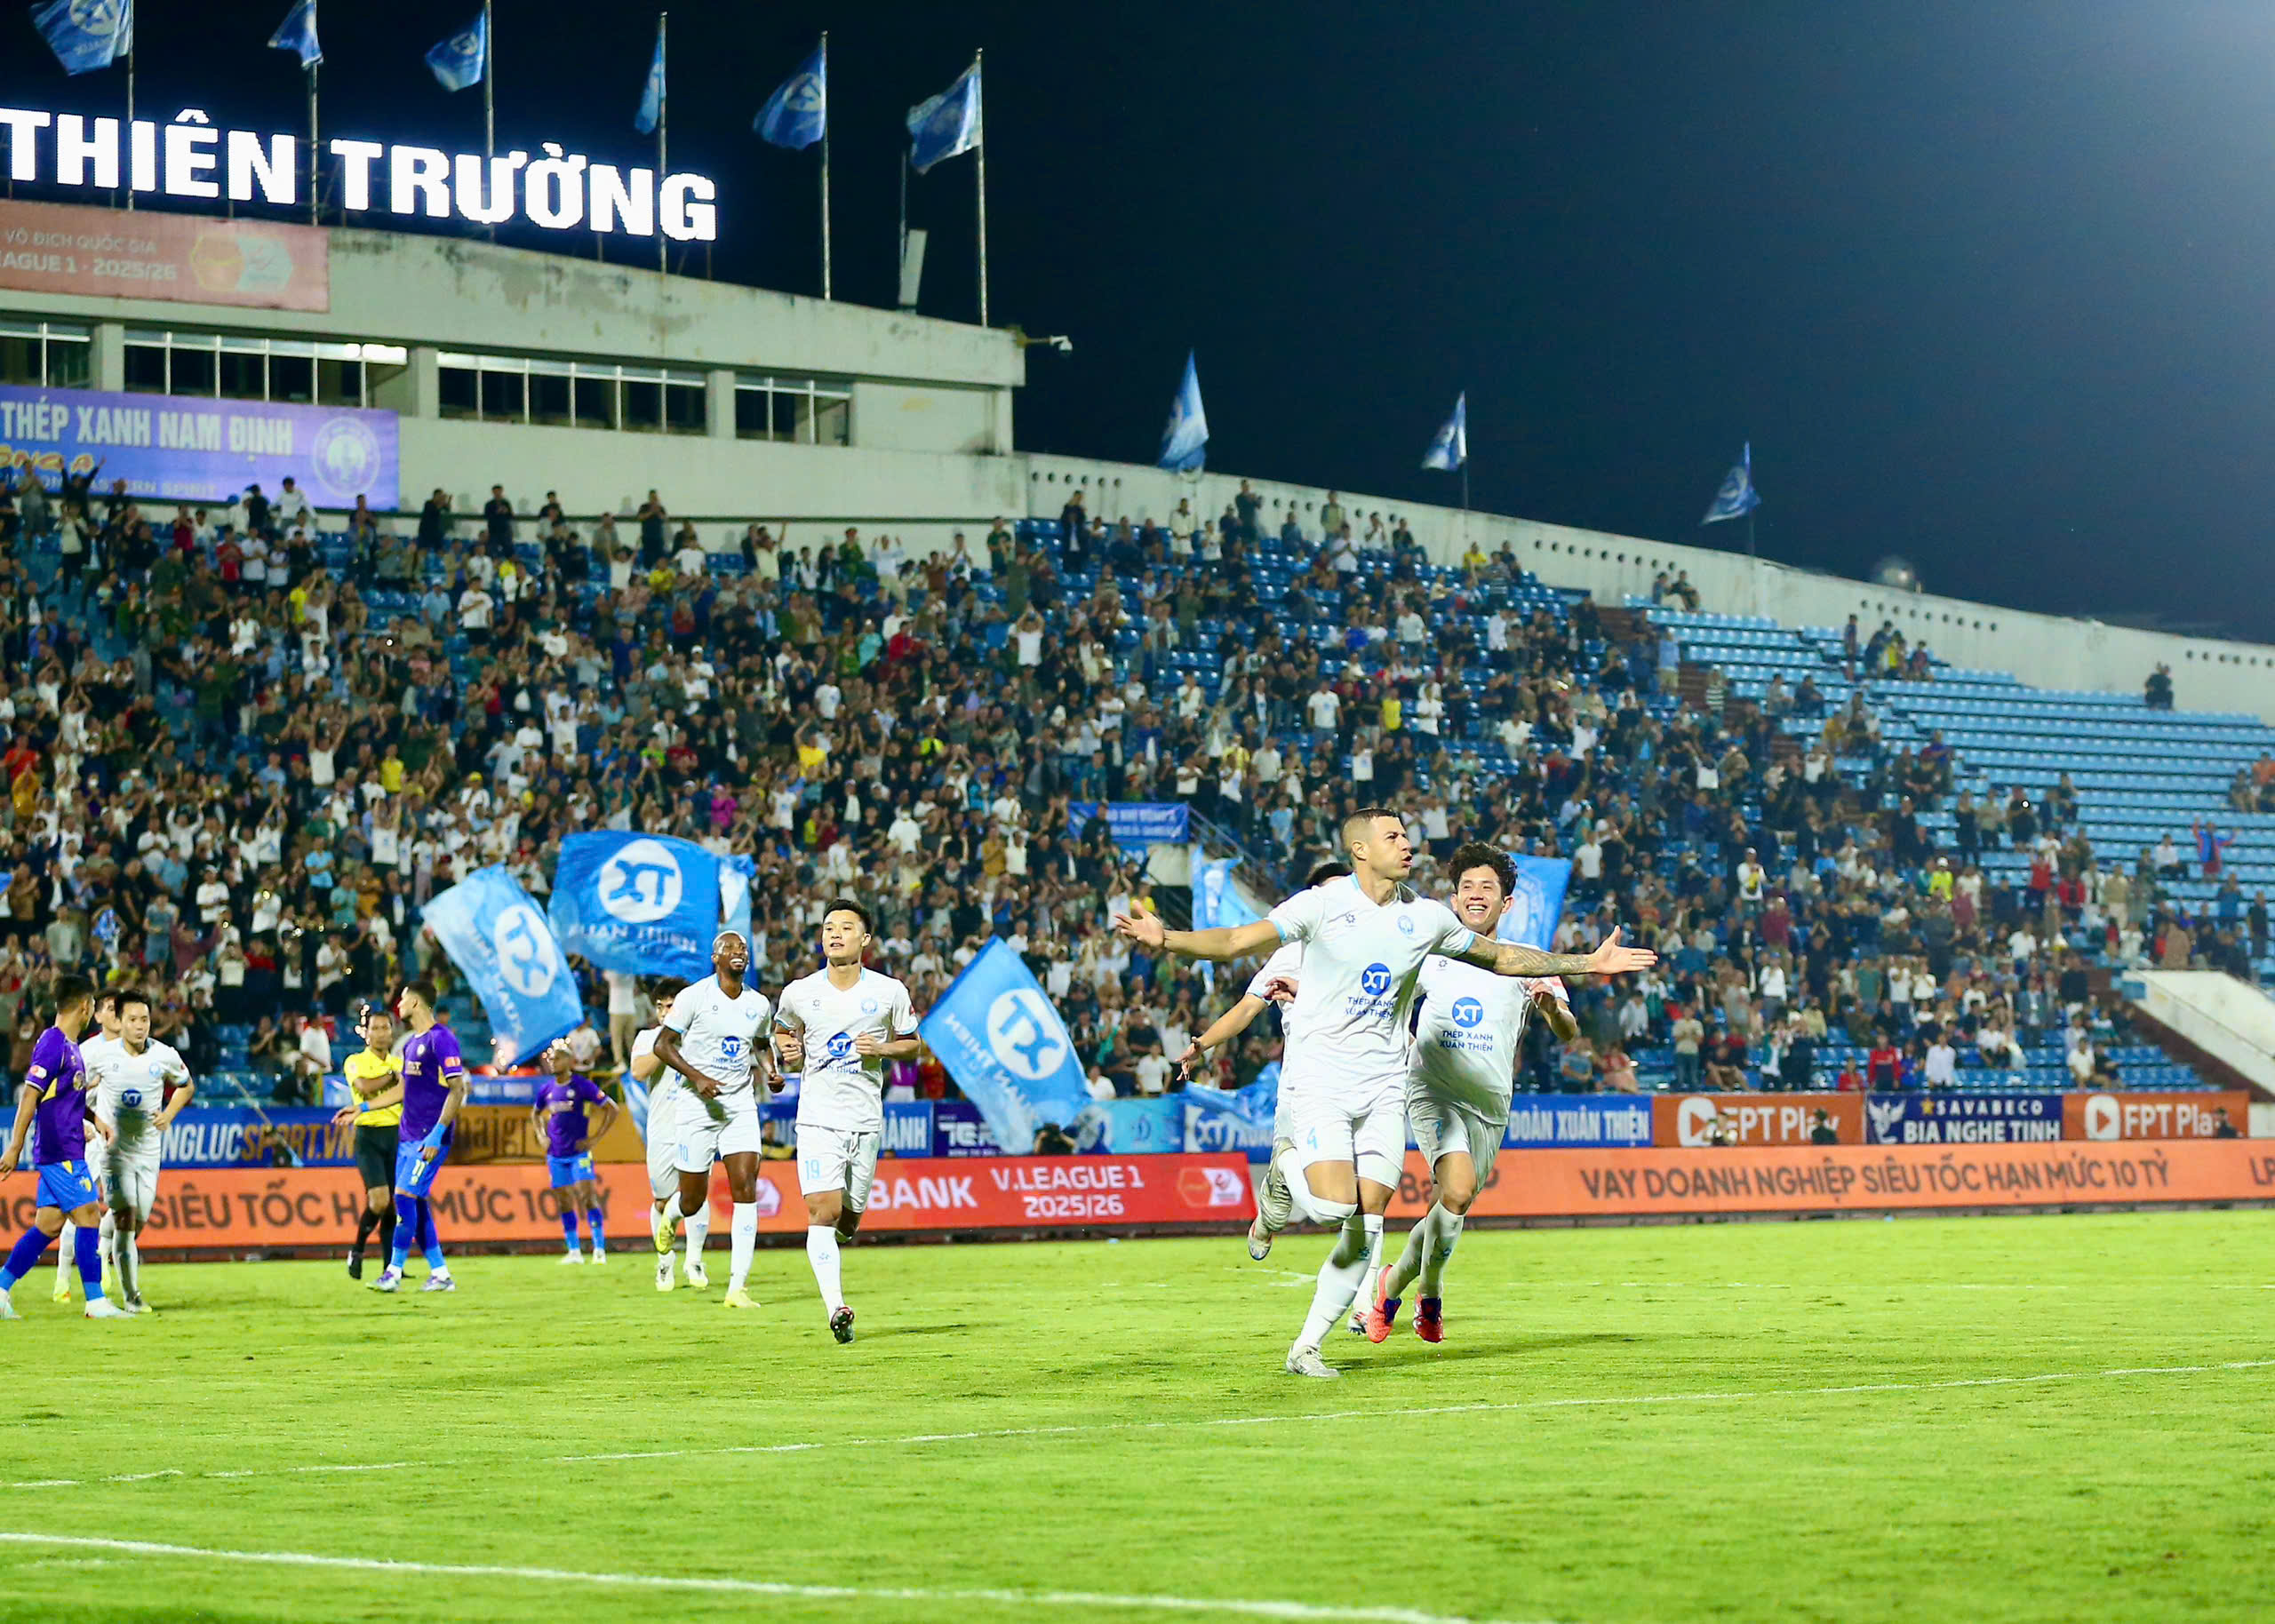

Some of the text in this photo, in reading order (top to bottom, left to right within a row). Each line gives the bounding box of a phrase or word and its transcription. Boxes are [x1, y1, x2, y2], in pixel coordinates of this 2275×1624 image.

[0, 107, 717, 242] THIÊN TRƯỜNG
[0, 250, 178, 281] AGUE 1 2025/26
[1, 397, 69, 442] THÉP
[76, 405, 151, 447] XANH
[159, 410, 221, 452] NAM
[1466, 1031, 1493, 1042] XANH
[1936, 1100, 2043, 1116] SAVABECO
[2124, 1103, 2215, 1137] FPT Pla
[1306, 1125, 1318, 1150] 4
[1903, 1119, 1941, 1143] BIA
[678, 1143, 690, 1163] 10
[804, 1159, 821, 1181] 19
[990, 1165, 1145, 1191] V.LEAGUE 1
[1580, 1168, 1637, 1199] VAY
[1644, 1166, 1752, 1198] DOANH
[1755, 1157, 1856, 1204] NGHIỆP
[1860, 1155, 1921, 1194] SIÊU
[1921, 1152, 1982, 1192] TỐC
[1984, 1161, 2042, 1199] HẠN
[2043, 1150, 2106, 1191] MỨC
[2107, 1158, 2137, 1188] 10
[148, 1181, 232, 1230] SIÊU
[238, 1178, 324, 1228] TỐC
[1023, 1193, 1125, 1219] 2025/26
